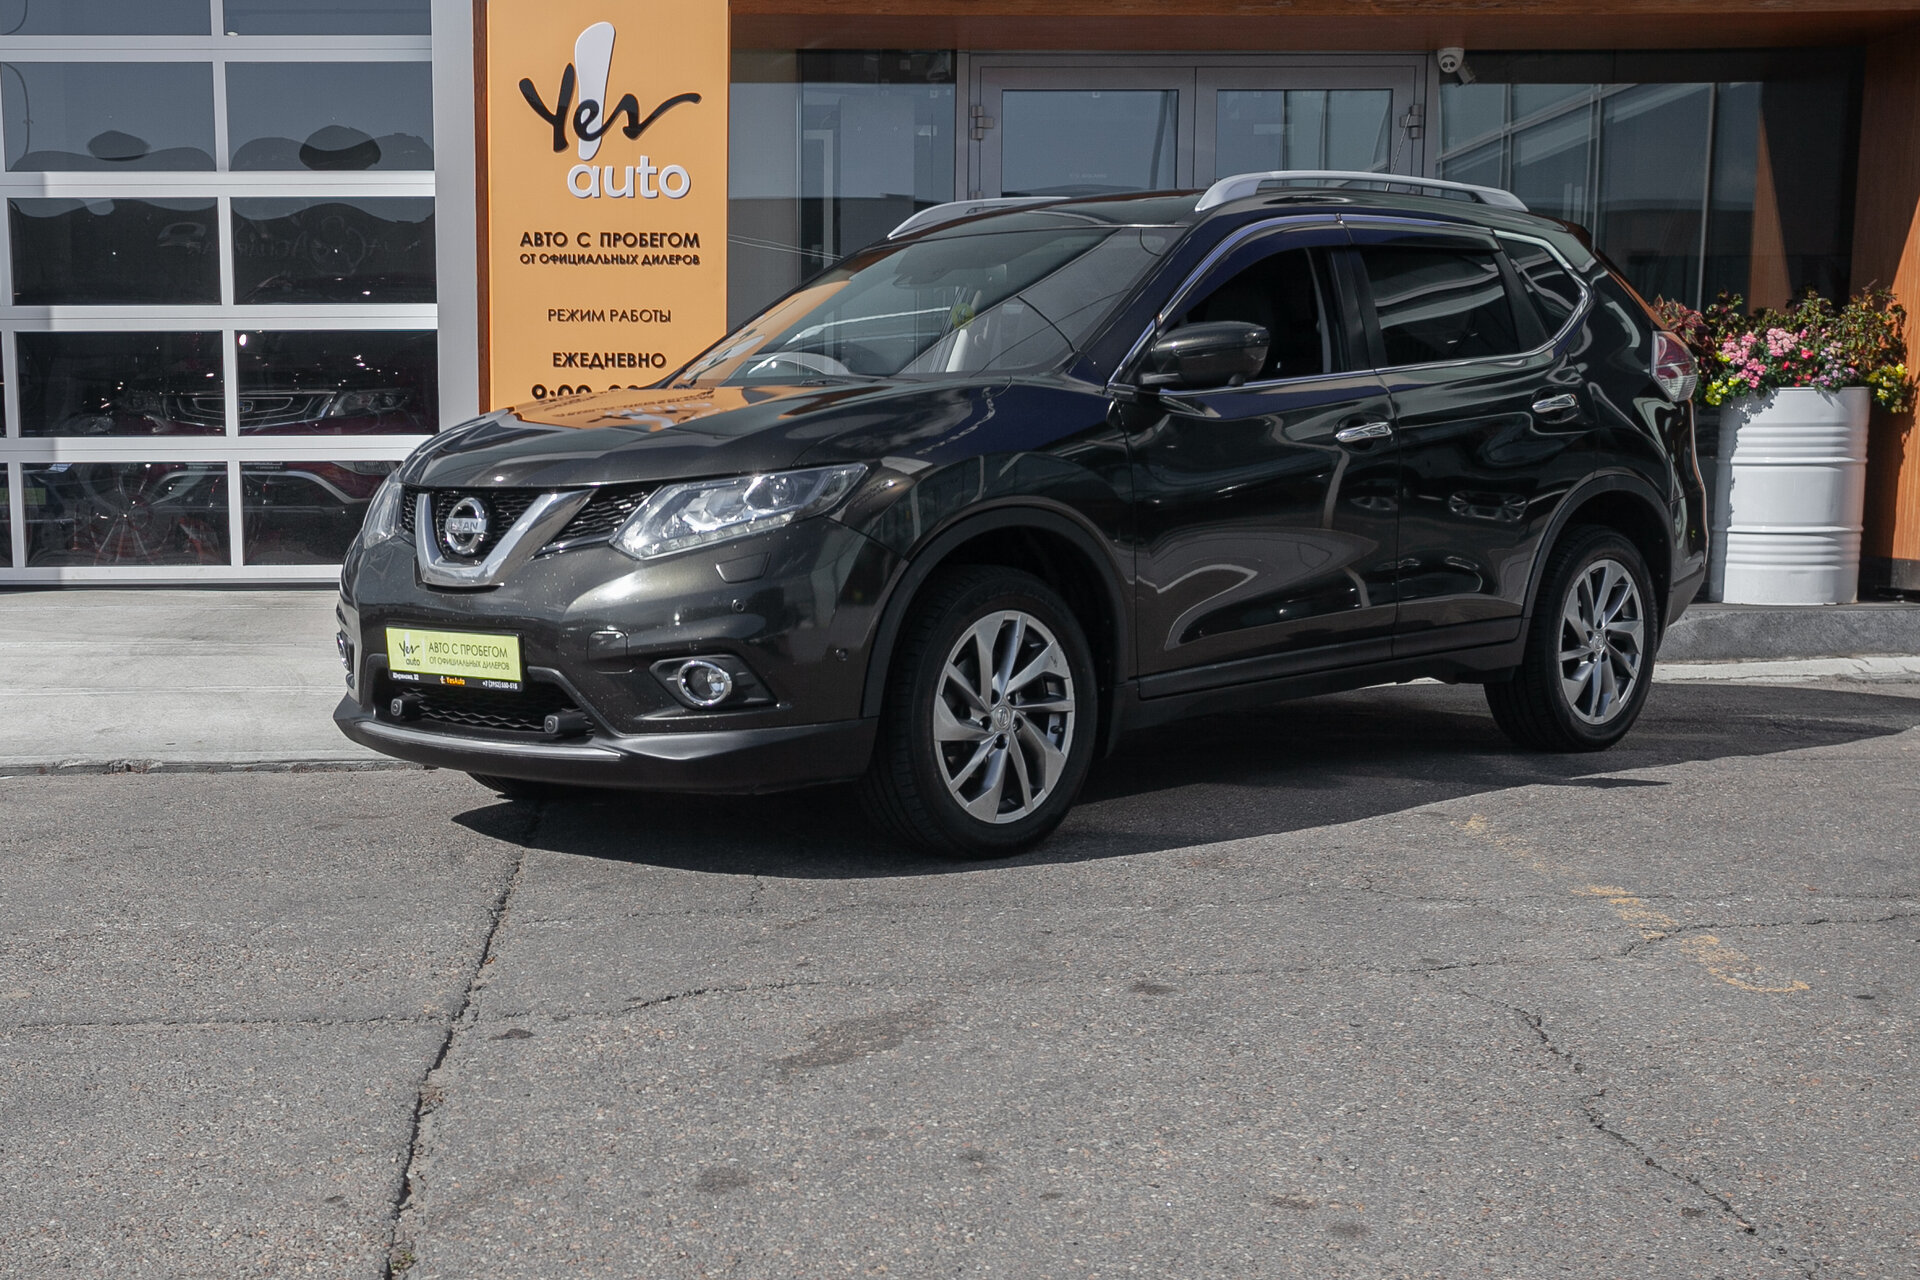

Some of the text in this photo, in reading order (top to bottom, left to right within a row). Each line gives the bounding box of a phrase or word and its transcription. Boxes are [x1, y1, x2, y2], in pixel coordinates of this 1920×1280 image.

[566, 155, 692, 199] auto
[519, 231, 701, 249] АВТО С ПРОБЕГОМ
[519, 253, 701, 266] ОТ ОФИЦИАЛЬНЫХ ДИЛЕРОВ
[547, 308, 672, 323] РЕЖИМ РАБОТЫ
[552, 352, 667, 370] ЕЖЕДНЕВНО
[428, 642, 508, 658] АВТО С ПРОБЕГОМ
[405, 657, 421, 667] auto
[428, 656, 510, 671] ОТ ОФИЦИАЛЬНЫХ ДИЛЕРОВ
